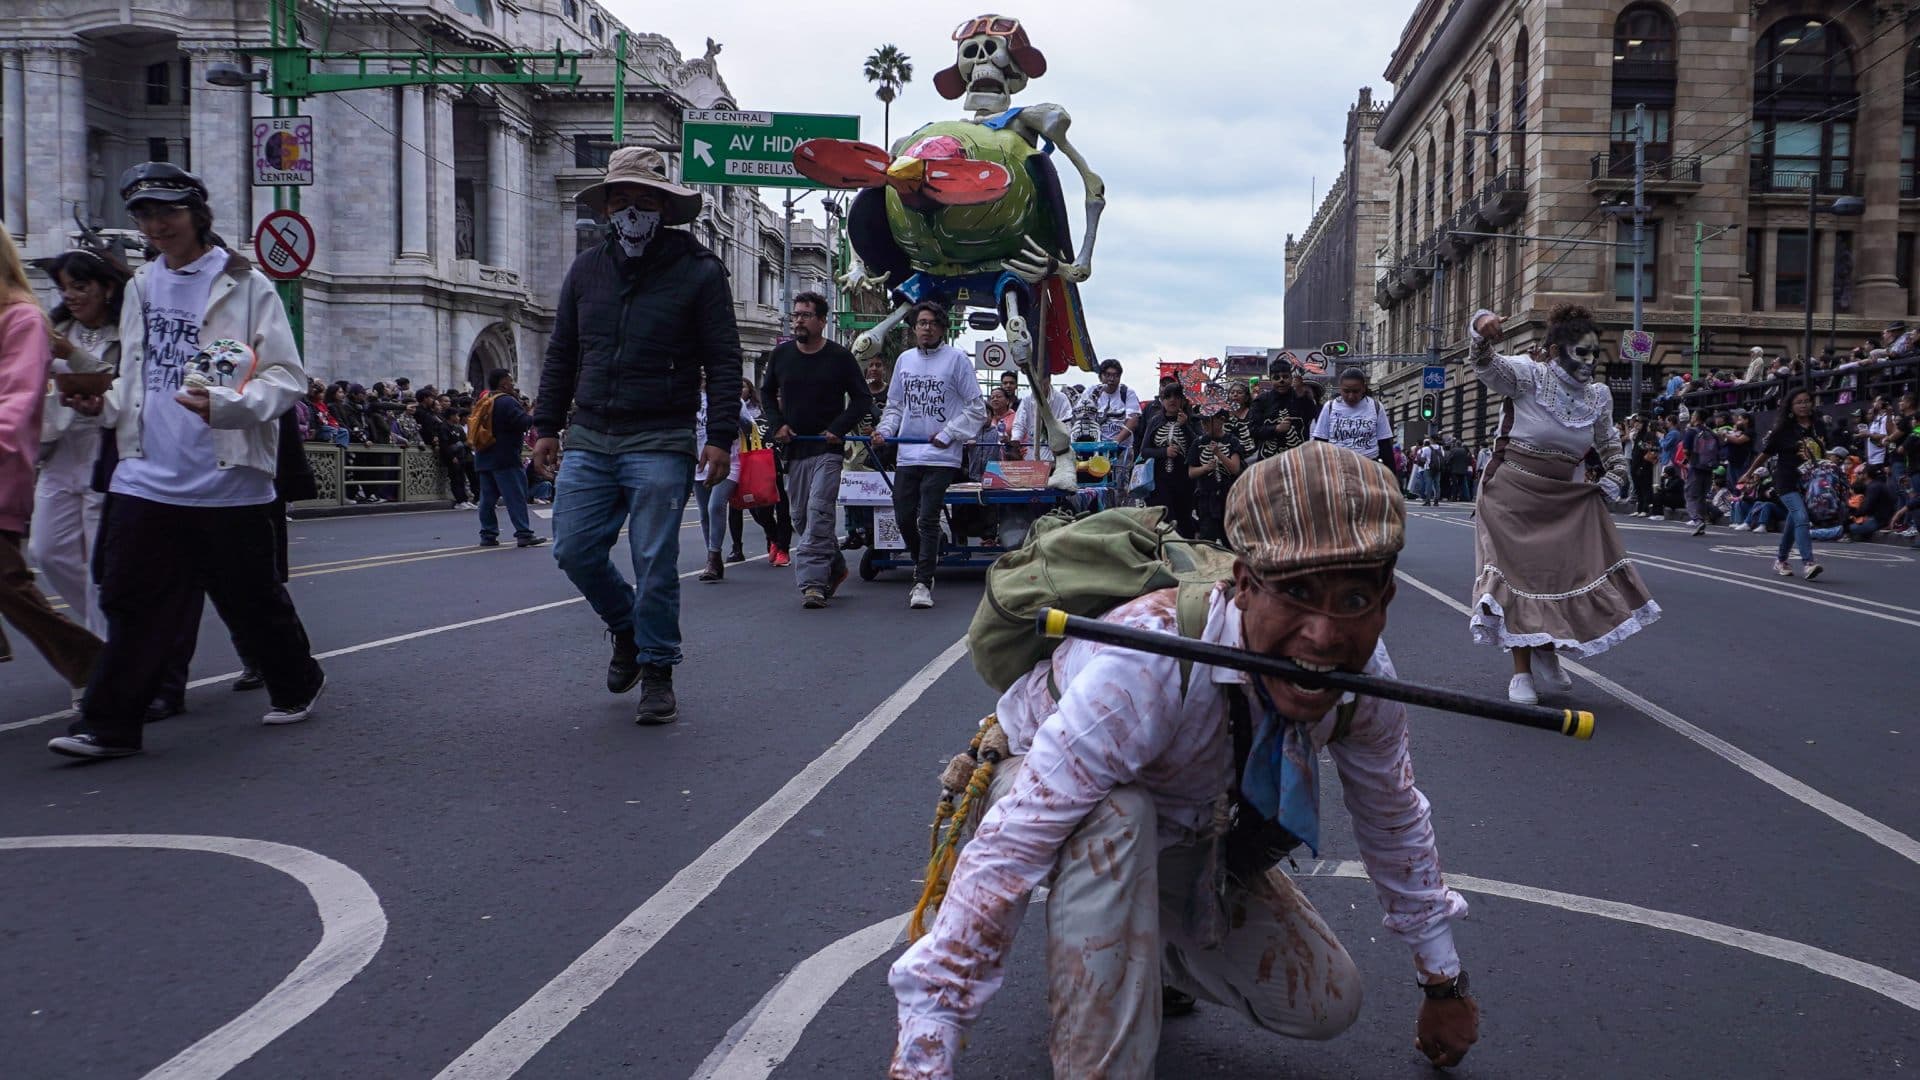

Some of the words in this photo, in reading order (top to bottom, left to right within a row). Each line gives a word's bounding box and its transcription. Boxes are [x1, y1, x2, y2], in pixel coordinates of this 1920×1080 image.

[688, 111, 709, 121] EJE
[714, 112, 765, 123] CENTRAL
[273, 120, 291, 129] EJE
[729, 134, 754, 151] AV
[763, 136, 806, 153] HIDA
[732, 162, 738, 173] P
[742, 162, 754, 174] DE
[757, 163, 793, 175] BELLAS
[261, 173, 305, 181] CENTRAL
